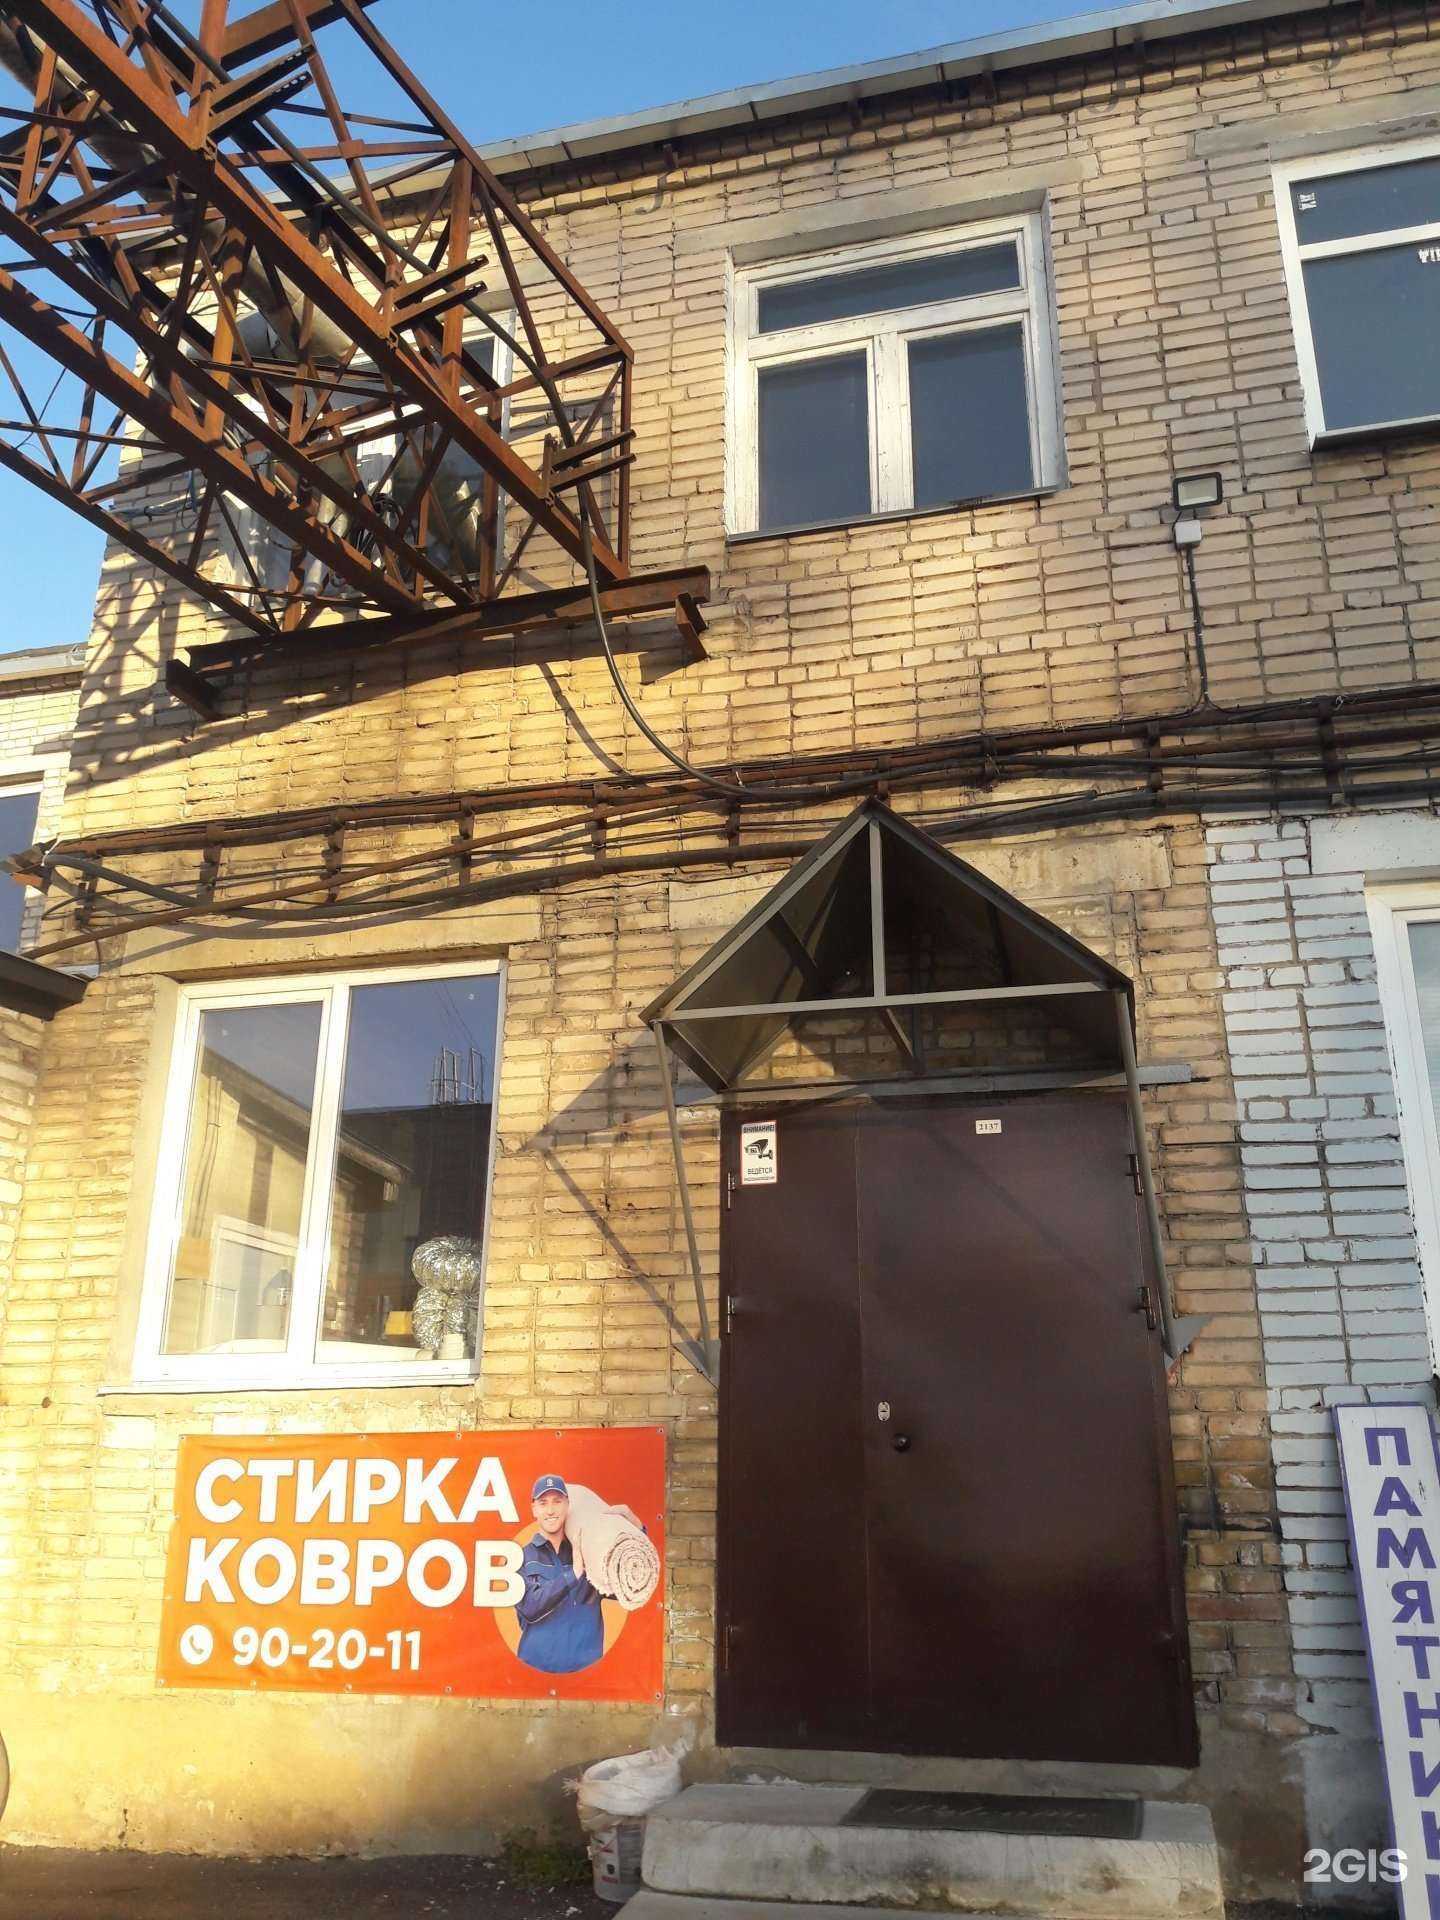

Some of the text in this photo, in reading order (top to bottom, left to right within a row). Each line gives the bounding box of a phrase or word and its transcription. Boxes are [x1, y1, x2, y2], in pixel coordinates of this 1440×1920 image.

[195, 1456, 519, 1524] СТИРКА
[184, 1538, 526, 1608] КОВРОВ
[232, 1626, 421, 1670] 90-20-11
